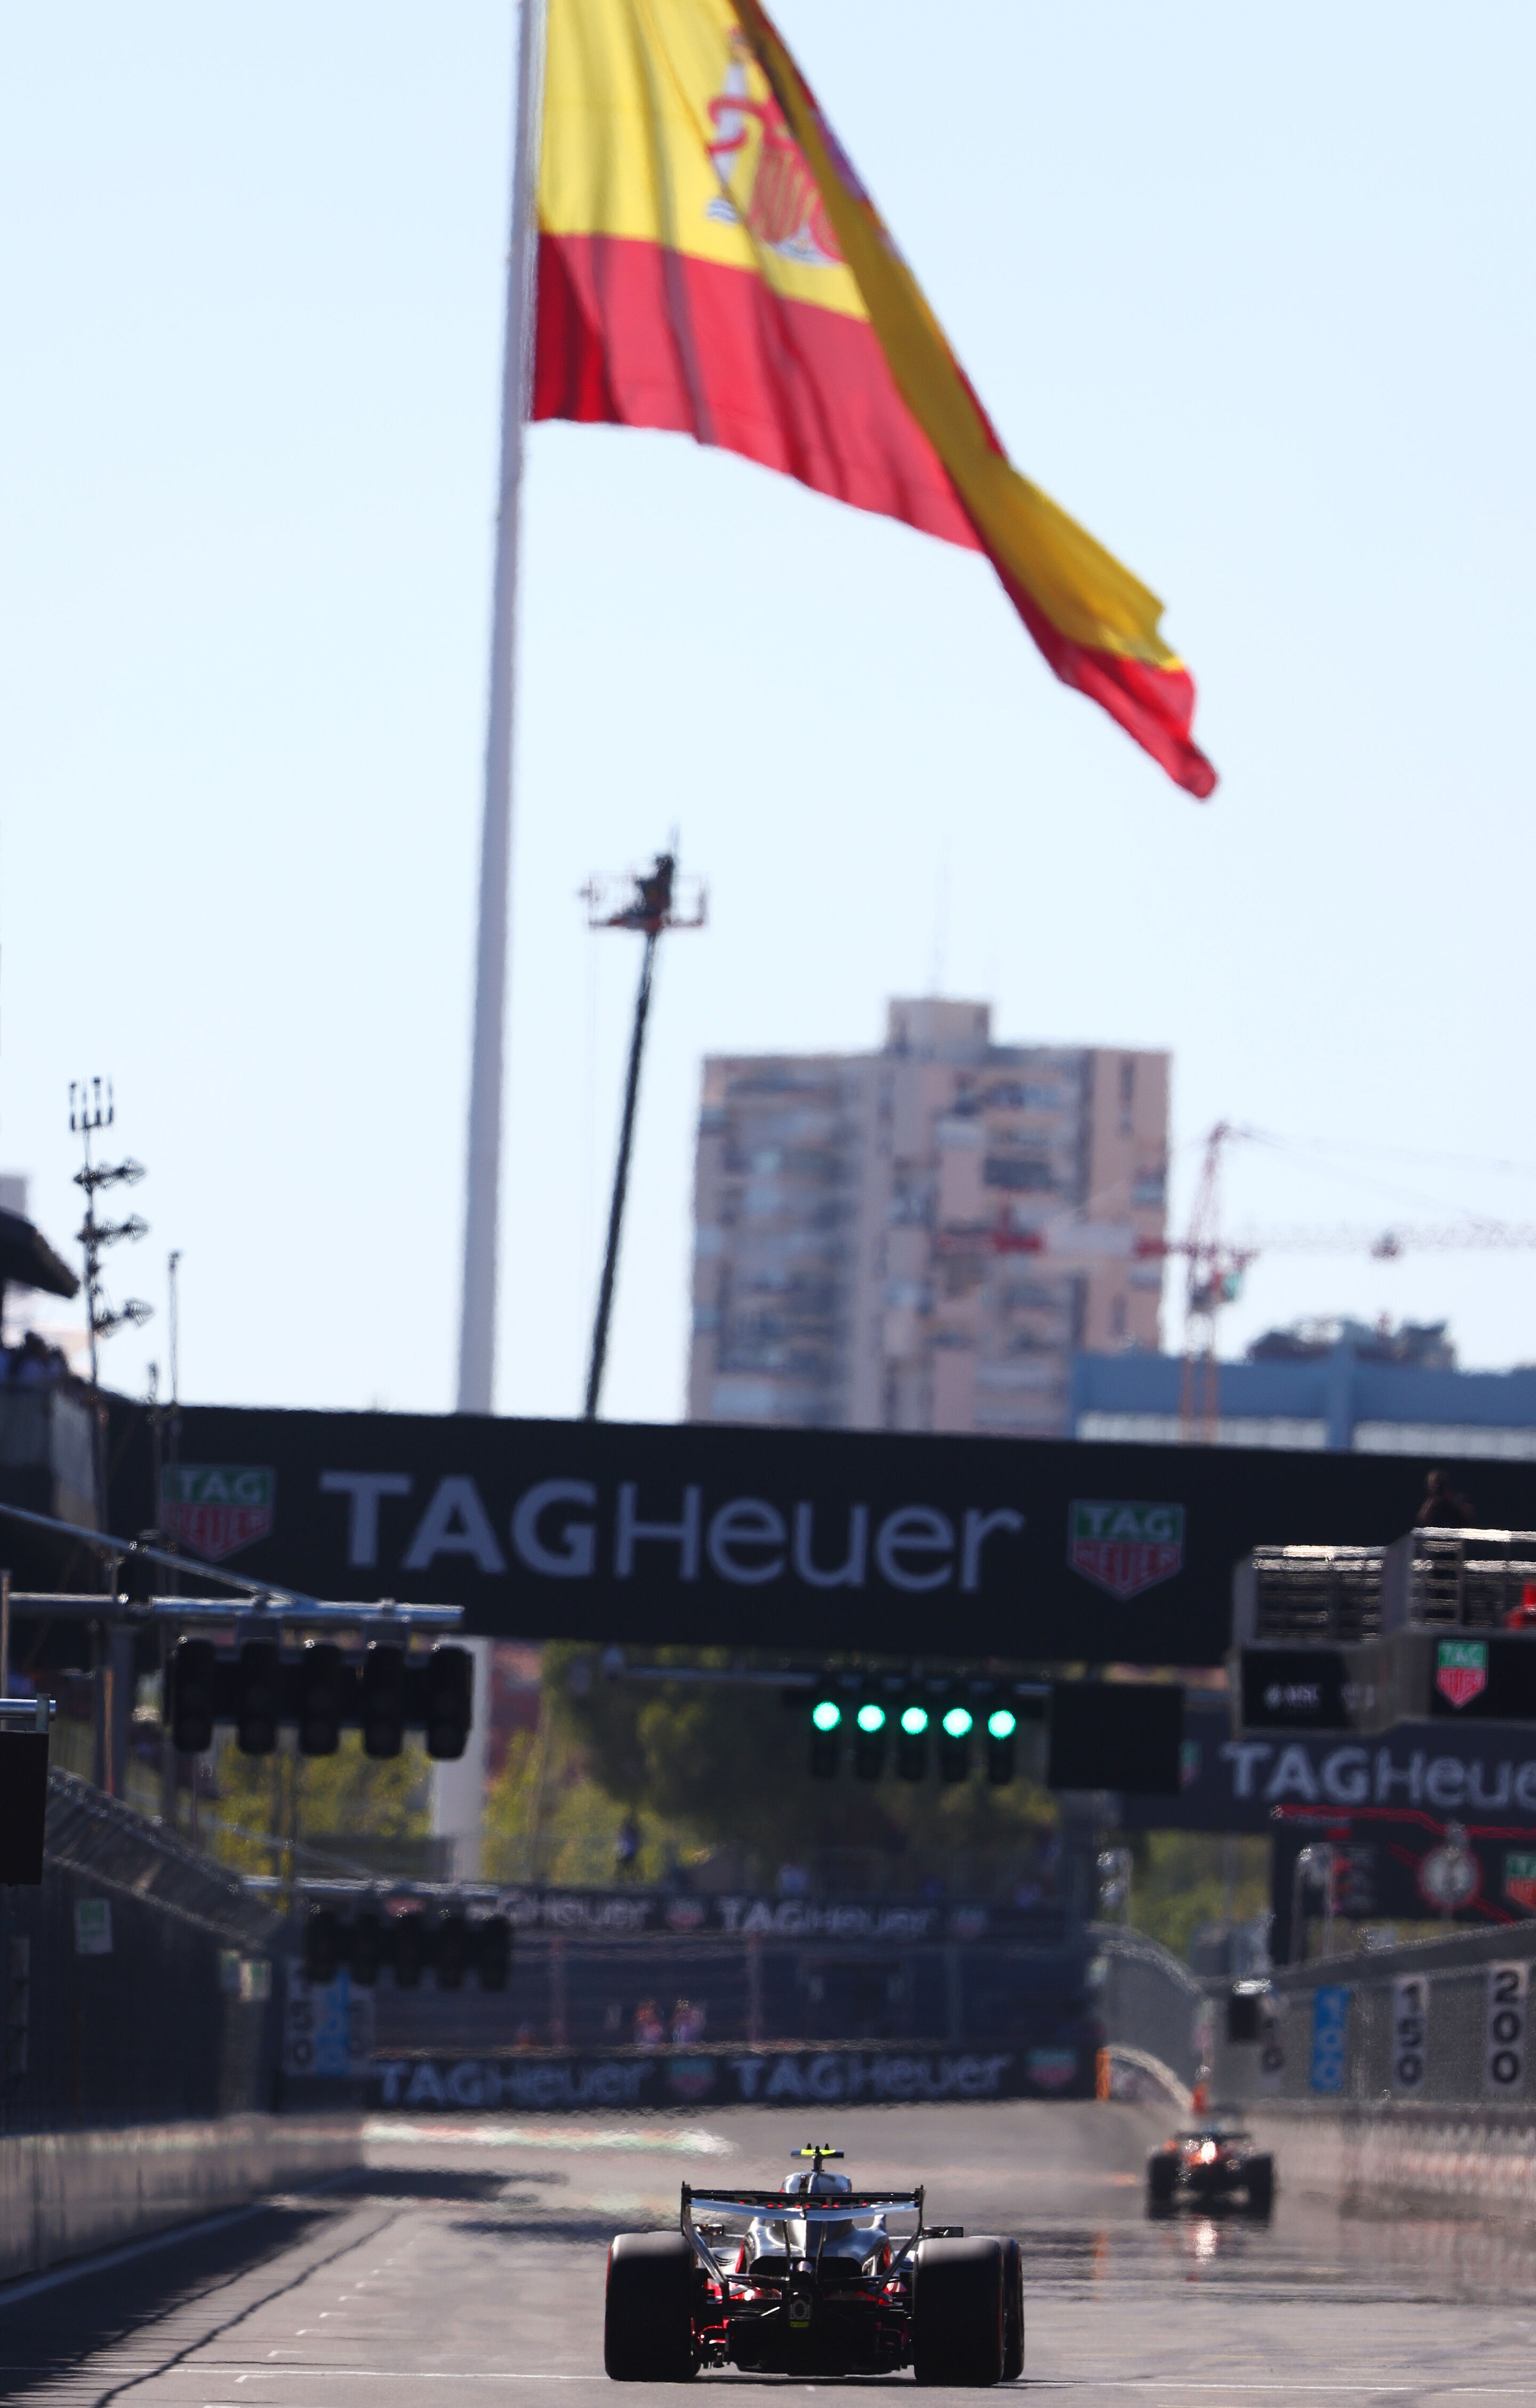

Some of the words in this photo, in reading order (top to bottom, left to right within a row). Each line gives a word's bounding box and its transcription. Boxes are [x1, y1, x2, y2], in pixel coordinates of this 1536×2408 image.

[176, 1469, 262, 1503] TAG
[1084, 1506, 1174, 1542] TAG
[1398, 1982, 1423, 2086] 150
[1493, 1970, 1521, 2084] 200
